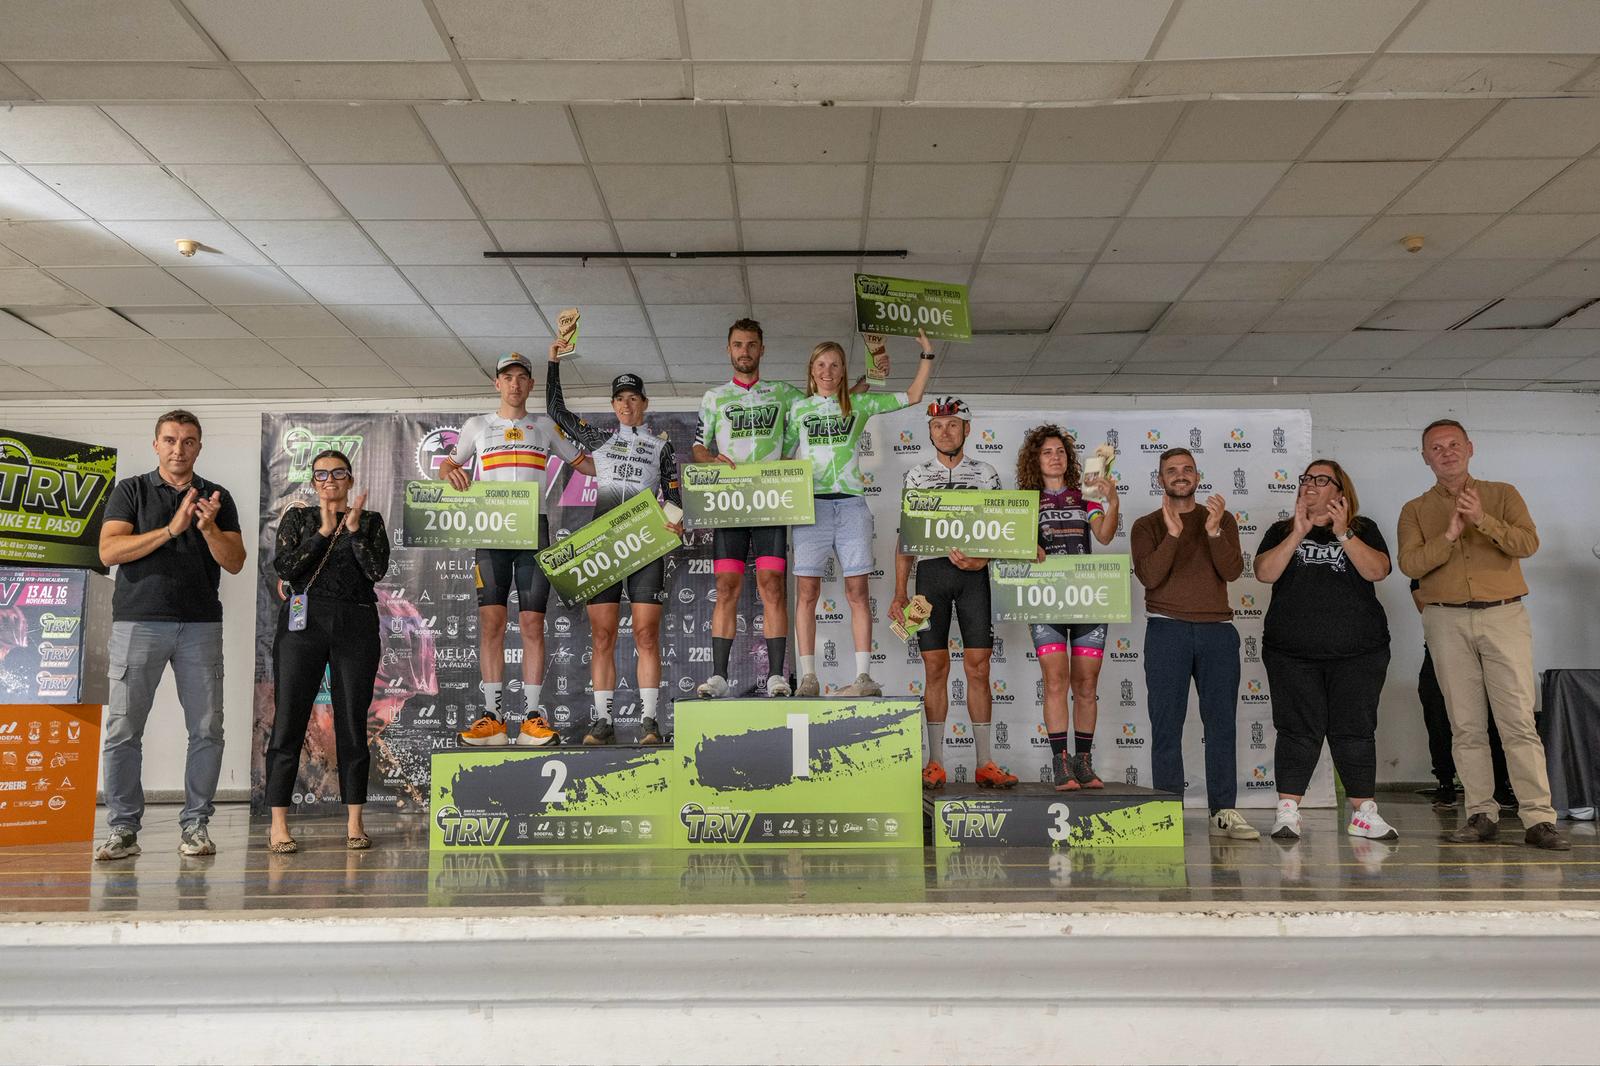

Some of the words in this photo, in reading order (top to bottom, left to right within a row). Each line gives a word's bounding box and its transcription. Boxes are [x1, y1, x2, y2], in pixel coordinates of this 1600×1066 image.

[874, 301, 954, 327] 300,00€
[731, 407, 777, 429] TRV
[808, 415, 856, 437] TRV
[731, 430, 746, 438] BIKE
[755, 428, 771, 436] PASO
[809, 437, 822, 445] BIKE
[832, 435, 848, 444] PASO
[482, 444, 545, 453] megamo
[689, 470, 720, 485] TRV
[760, 469, 781, 477] PRIMER
[783, 468, 804, 476] PUESTO
[0, 462, 100, 511] TRV
[410, 487, 442, 503] TRV
[485, 490, 510, 498] SEGUNDO
[511, 490, 530, 498] PUESTO
[703, 489, 794, 514] 300,00€
[909, 496, 941, 511] TRV
[984, 499, 1005, 507] TERCER
[1007, 499, 1030, 507] PUESTO
[424, 510, 518, 535] 200,00€
[609, 511, 632, 528] SEGUNDO
[631, 500, 650, 516] PUESTO
[26, 515, 42, 529] EL
[45, 518, 81, 534] PASO
[924, 519, 1016, 543] 100,00€
[546, 543, 576, 570] TRV
[569, 525, 656, 587] 200,00€
[1306, 546, 1341, 558] TRV
[999, 563, 1031, 578] TRV
[1075, 563, 1096, 571] TERCER
[1099, 563, 1120, 571] PUESTO
[27, 585, 38, 598] 13
[40, 586, 53, 598] AL
[56, 586, 68, 598] 16
[1017, 585, 1110, 610] 100,00€
[913, 601, 926, 614] TRV
[44, 619, 76, 632] TRV
[42, 647, 74, 660] TRV
[40, 677, 72, 690] TRV
[787, 714, 809, 777] 1
[541, 760, 567, 803] 2
[441, 817, 503, 843] TRV
[685, 814, 745, 840] TRV
[946, 813, 1006, 838] TRV
[1047, 803, 1071, 841] 3
